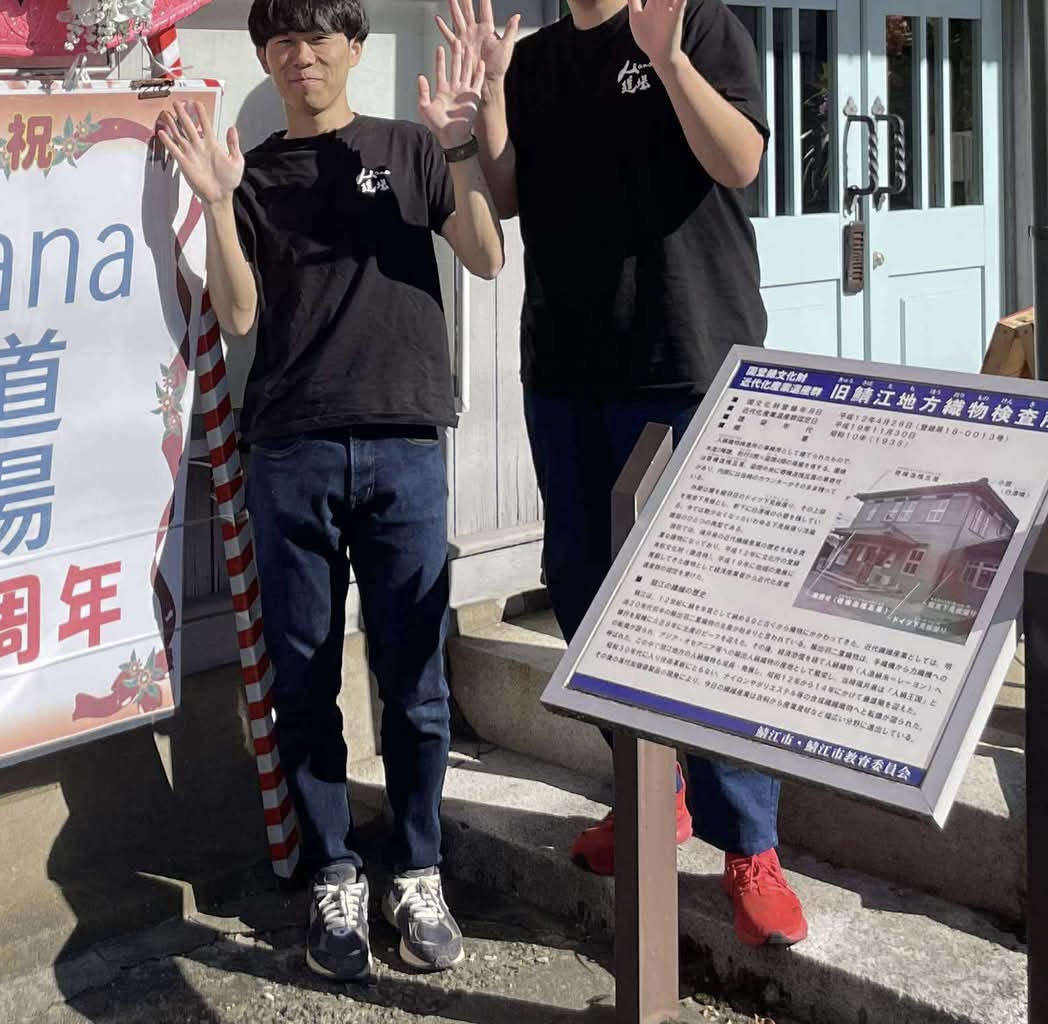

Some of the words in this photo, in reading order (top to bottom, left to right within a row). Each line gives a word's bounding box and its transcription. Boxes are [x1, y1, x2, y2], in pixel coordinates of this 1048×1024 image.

[7, 113, 54, 172] 祝
[753, 725, 914, 781] 鯖江市・鯖江市教育委員会
